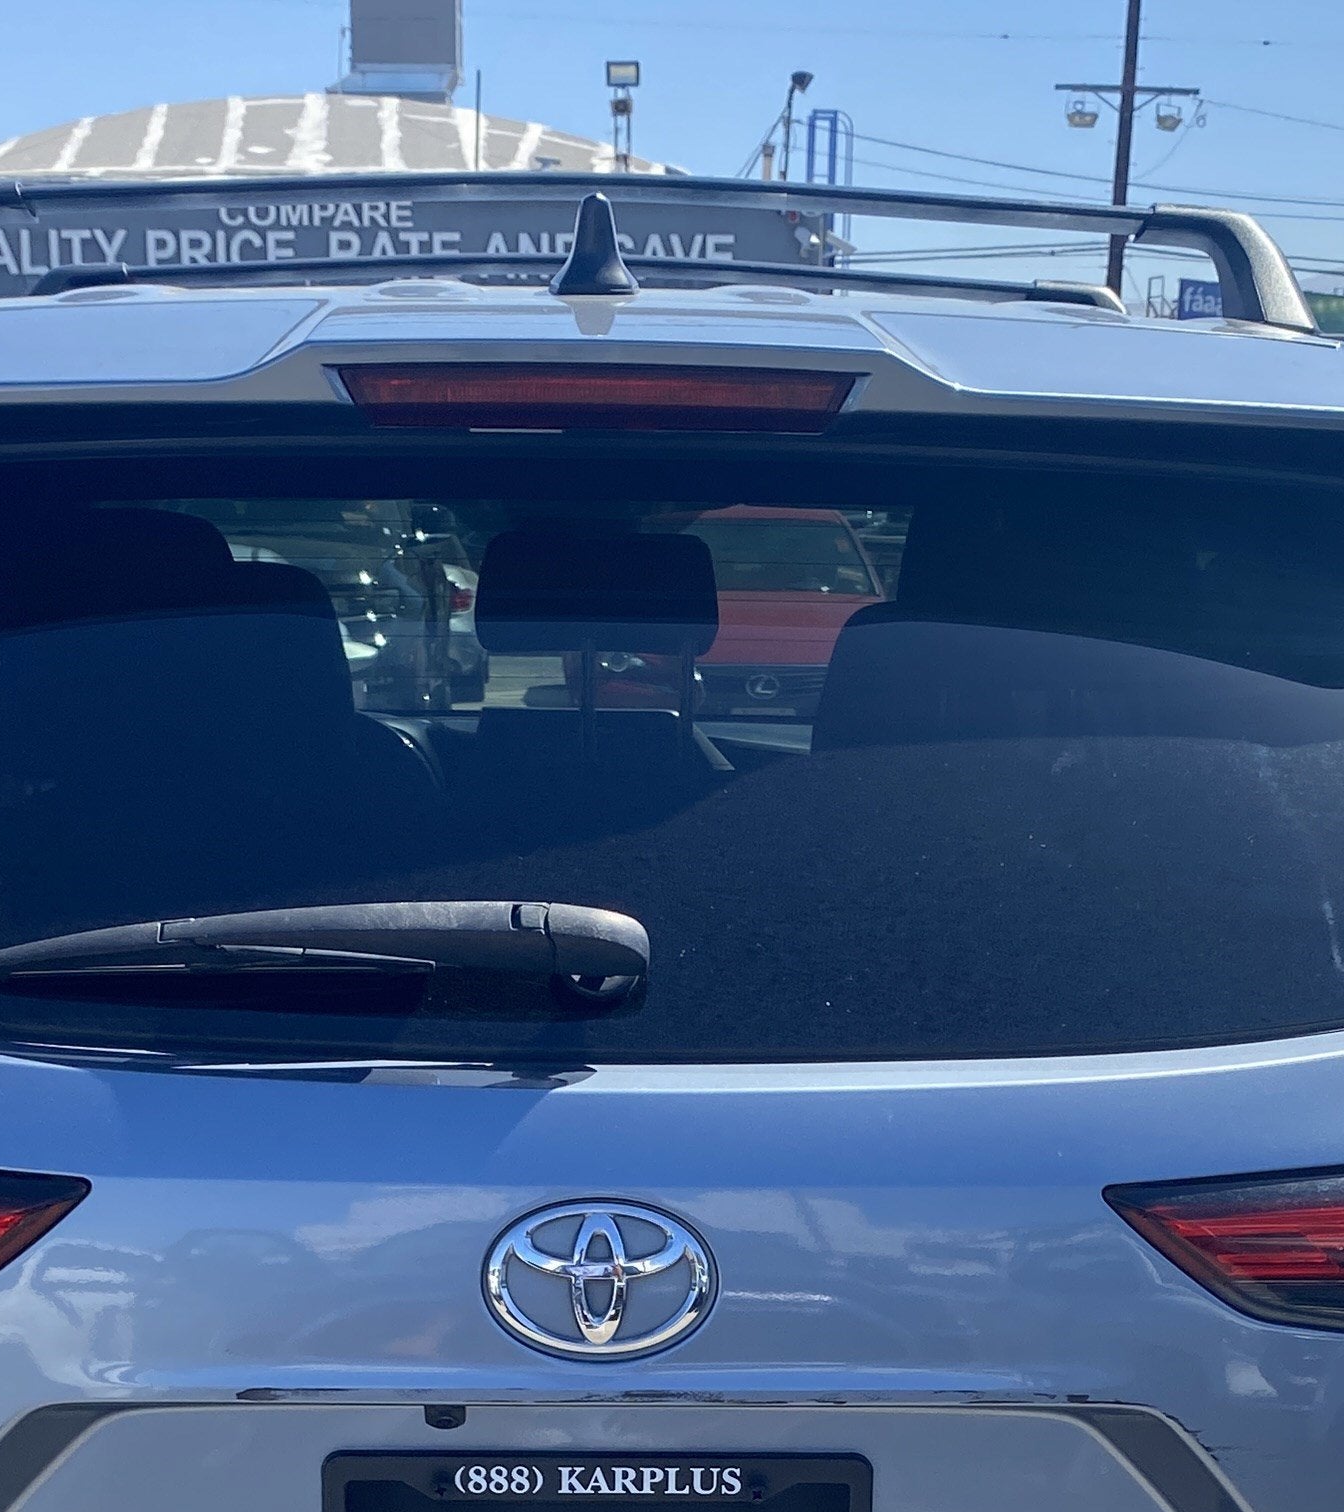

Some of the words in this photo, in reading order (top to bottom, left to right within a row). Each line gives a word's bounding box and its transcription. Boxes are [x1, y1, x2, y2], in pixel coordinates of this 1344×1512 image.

[218, 201, 414, 228] COMPARE
[145, 229, 297, 265] PRICE
[453, 1465, 544, 1496] (888)
[557, 1466, 742, 1495] KARPLUS
